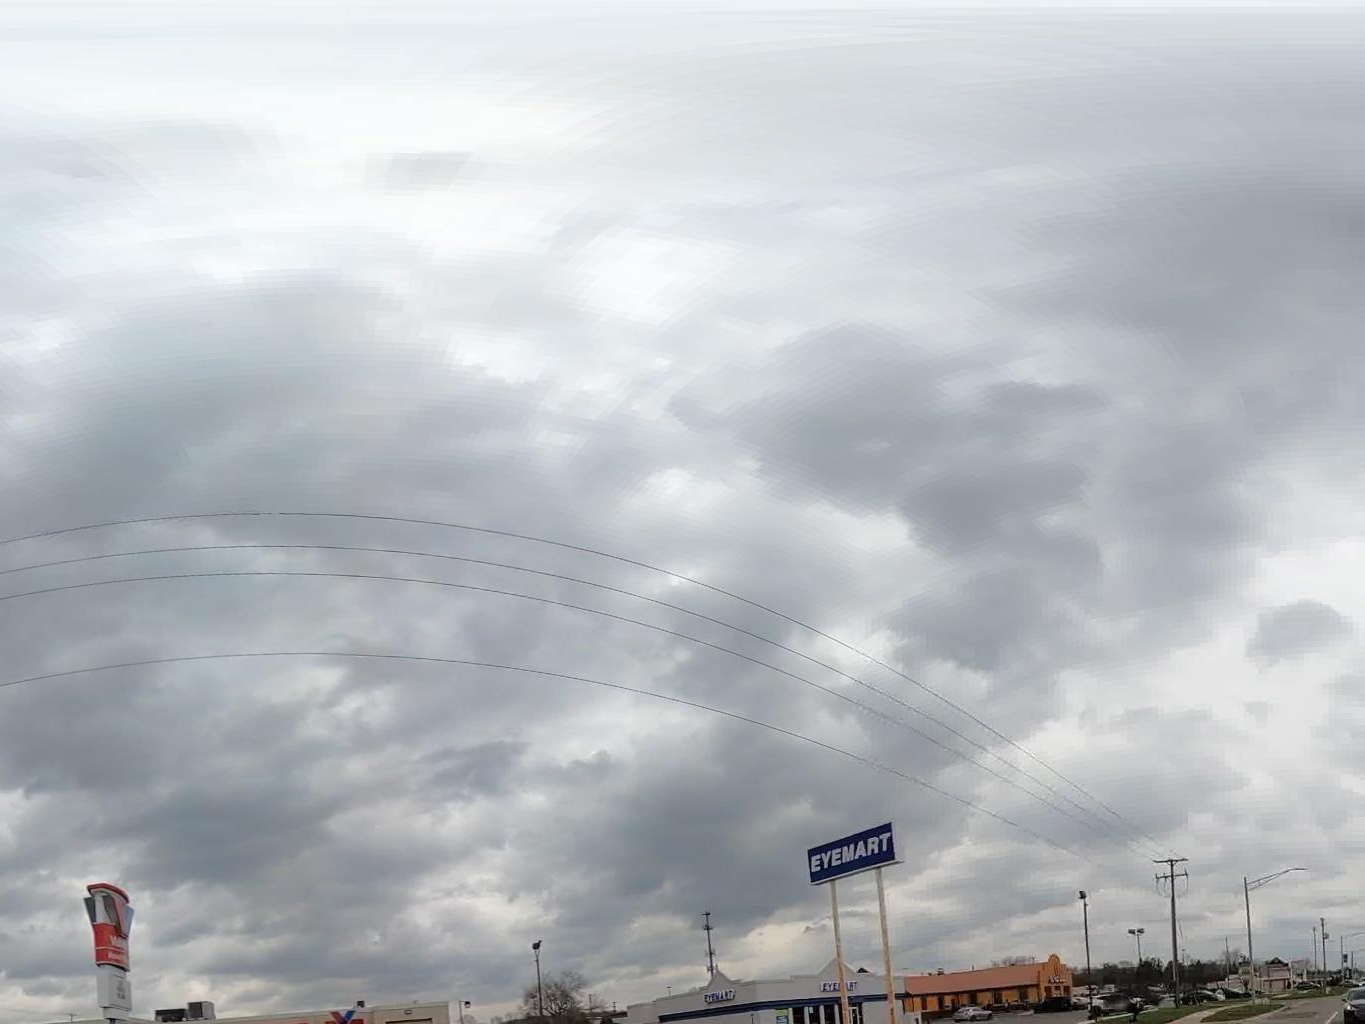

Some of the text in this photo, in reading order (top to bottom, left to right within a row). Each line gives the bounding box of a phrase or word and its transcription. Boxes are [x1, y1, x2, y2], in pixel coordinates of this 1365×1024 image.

[811, 832, 891, 873] EYEMART
[823, 981, 858, 991] EYEART
[704, 990, 734, 1003] EYEMART
